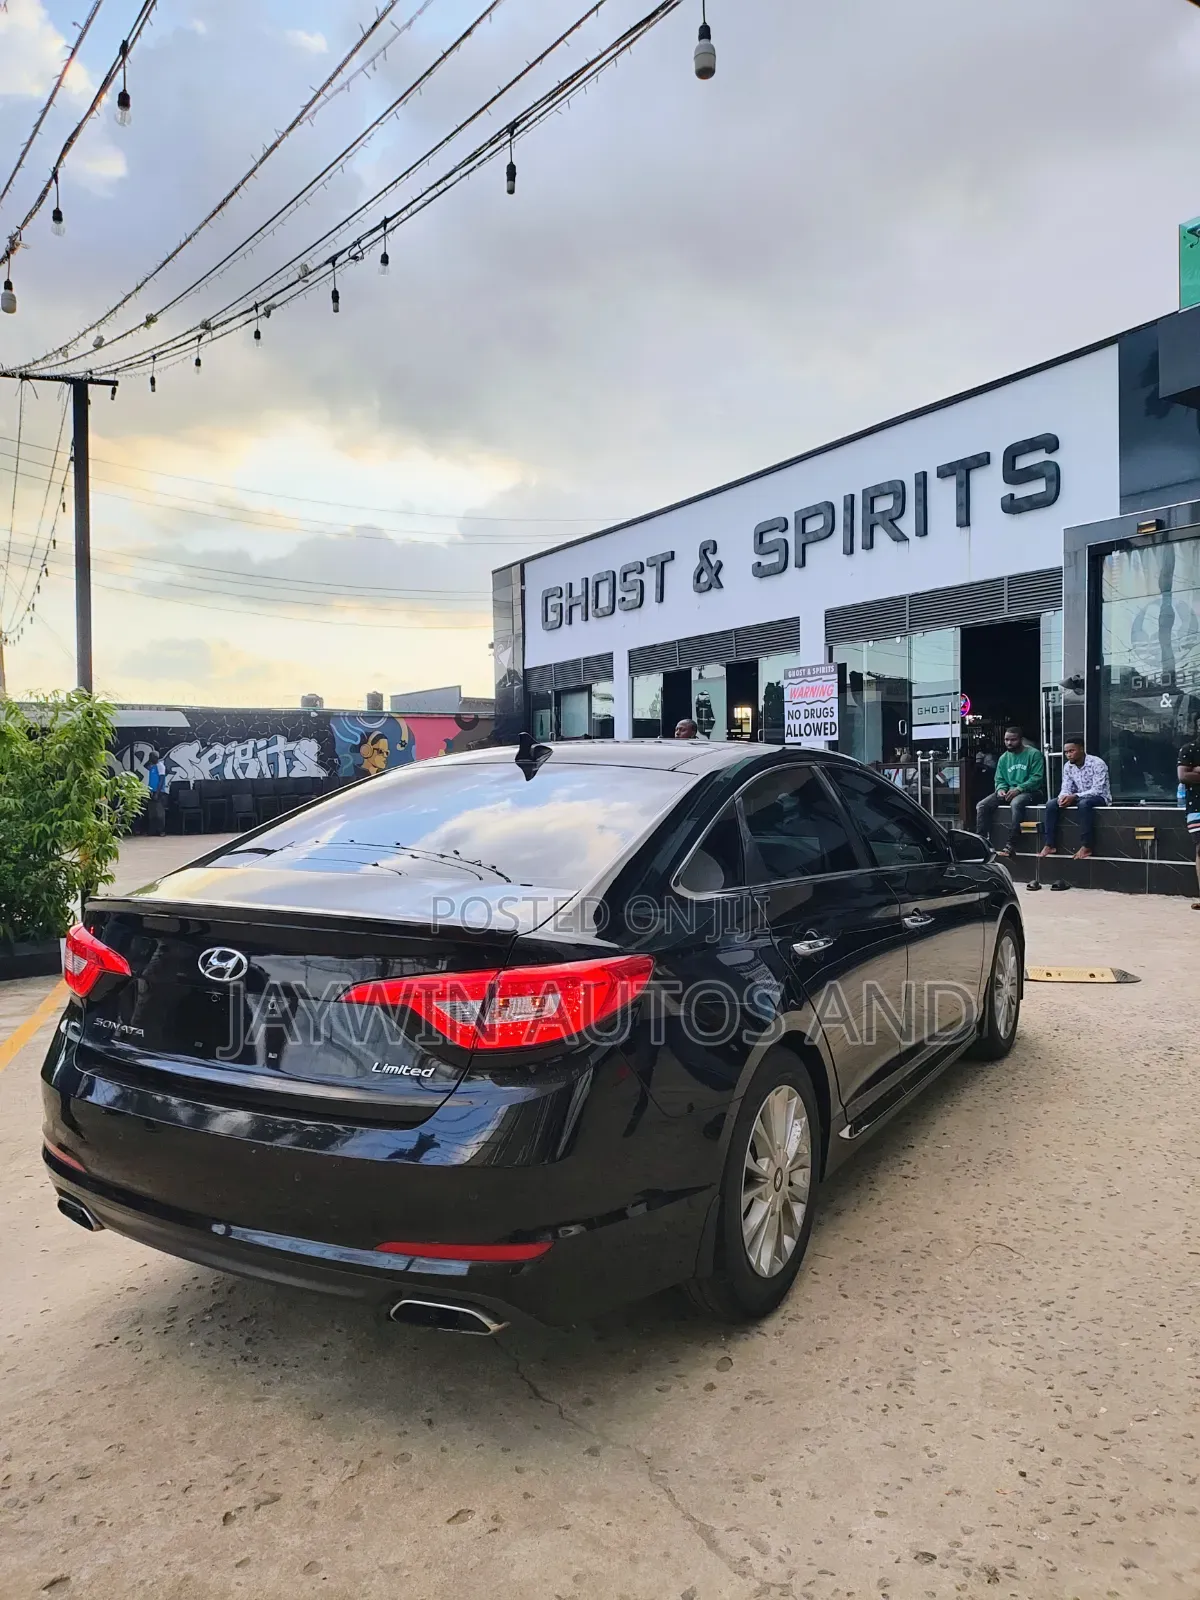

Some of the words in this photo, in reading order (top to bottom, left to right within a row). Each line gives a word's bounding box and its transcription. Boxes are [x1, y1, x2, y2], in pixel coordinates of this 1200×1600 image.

[541, 550, 675, 631] GHOST
[692, 539, 723, 594] &
[751, 432, 1061, 579] SPIRITS
[788, 669, 806, 678] GHOST
[812, 665, 835, 675] SPIRITS
[789, 684, 835, 700] WARNING
[1160, 693, 1172, 708] &
[787, 709, 801, 720] NO
[804, 707, 835, 719] DRUGS
[786, 721, 837, 738] ALLOWED
[93, 1017, 145, 1038] SONATA
[372, 1062, 435, 1077] Limited
